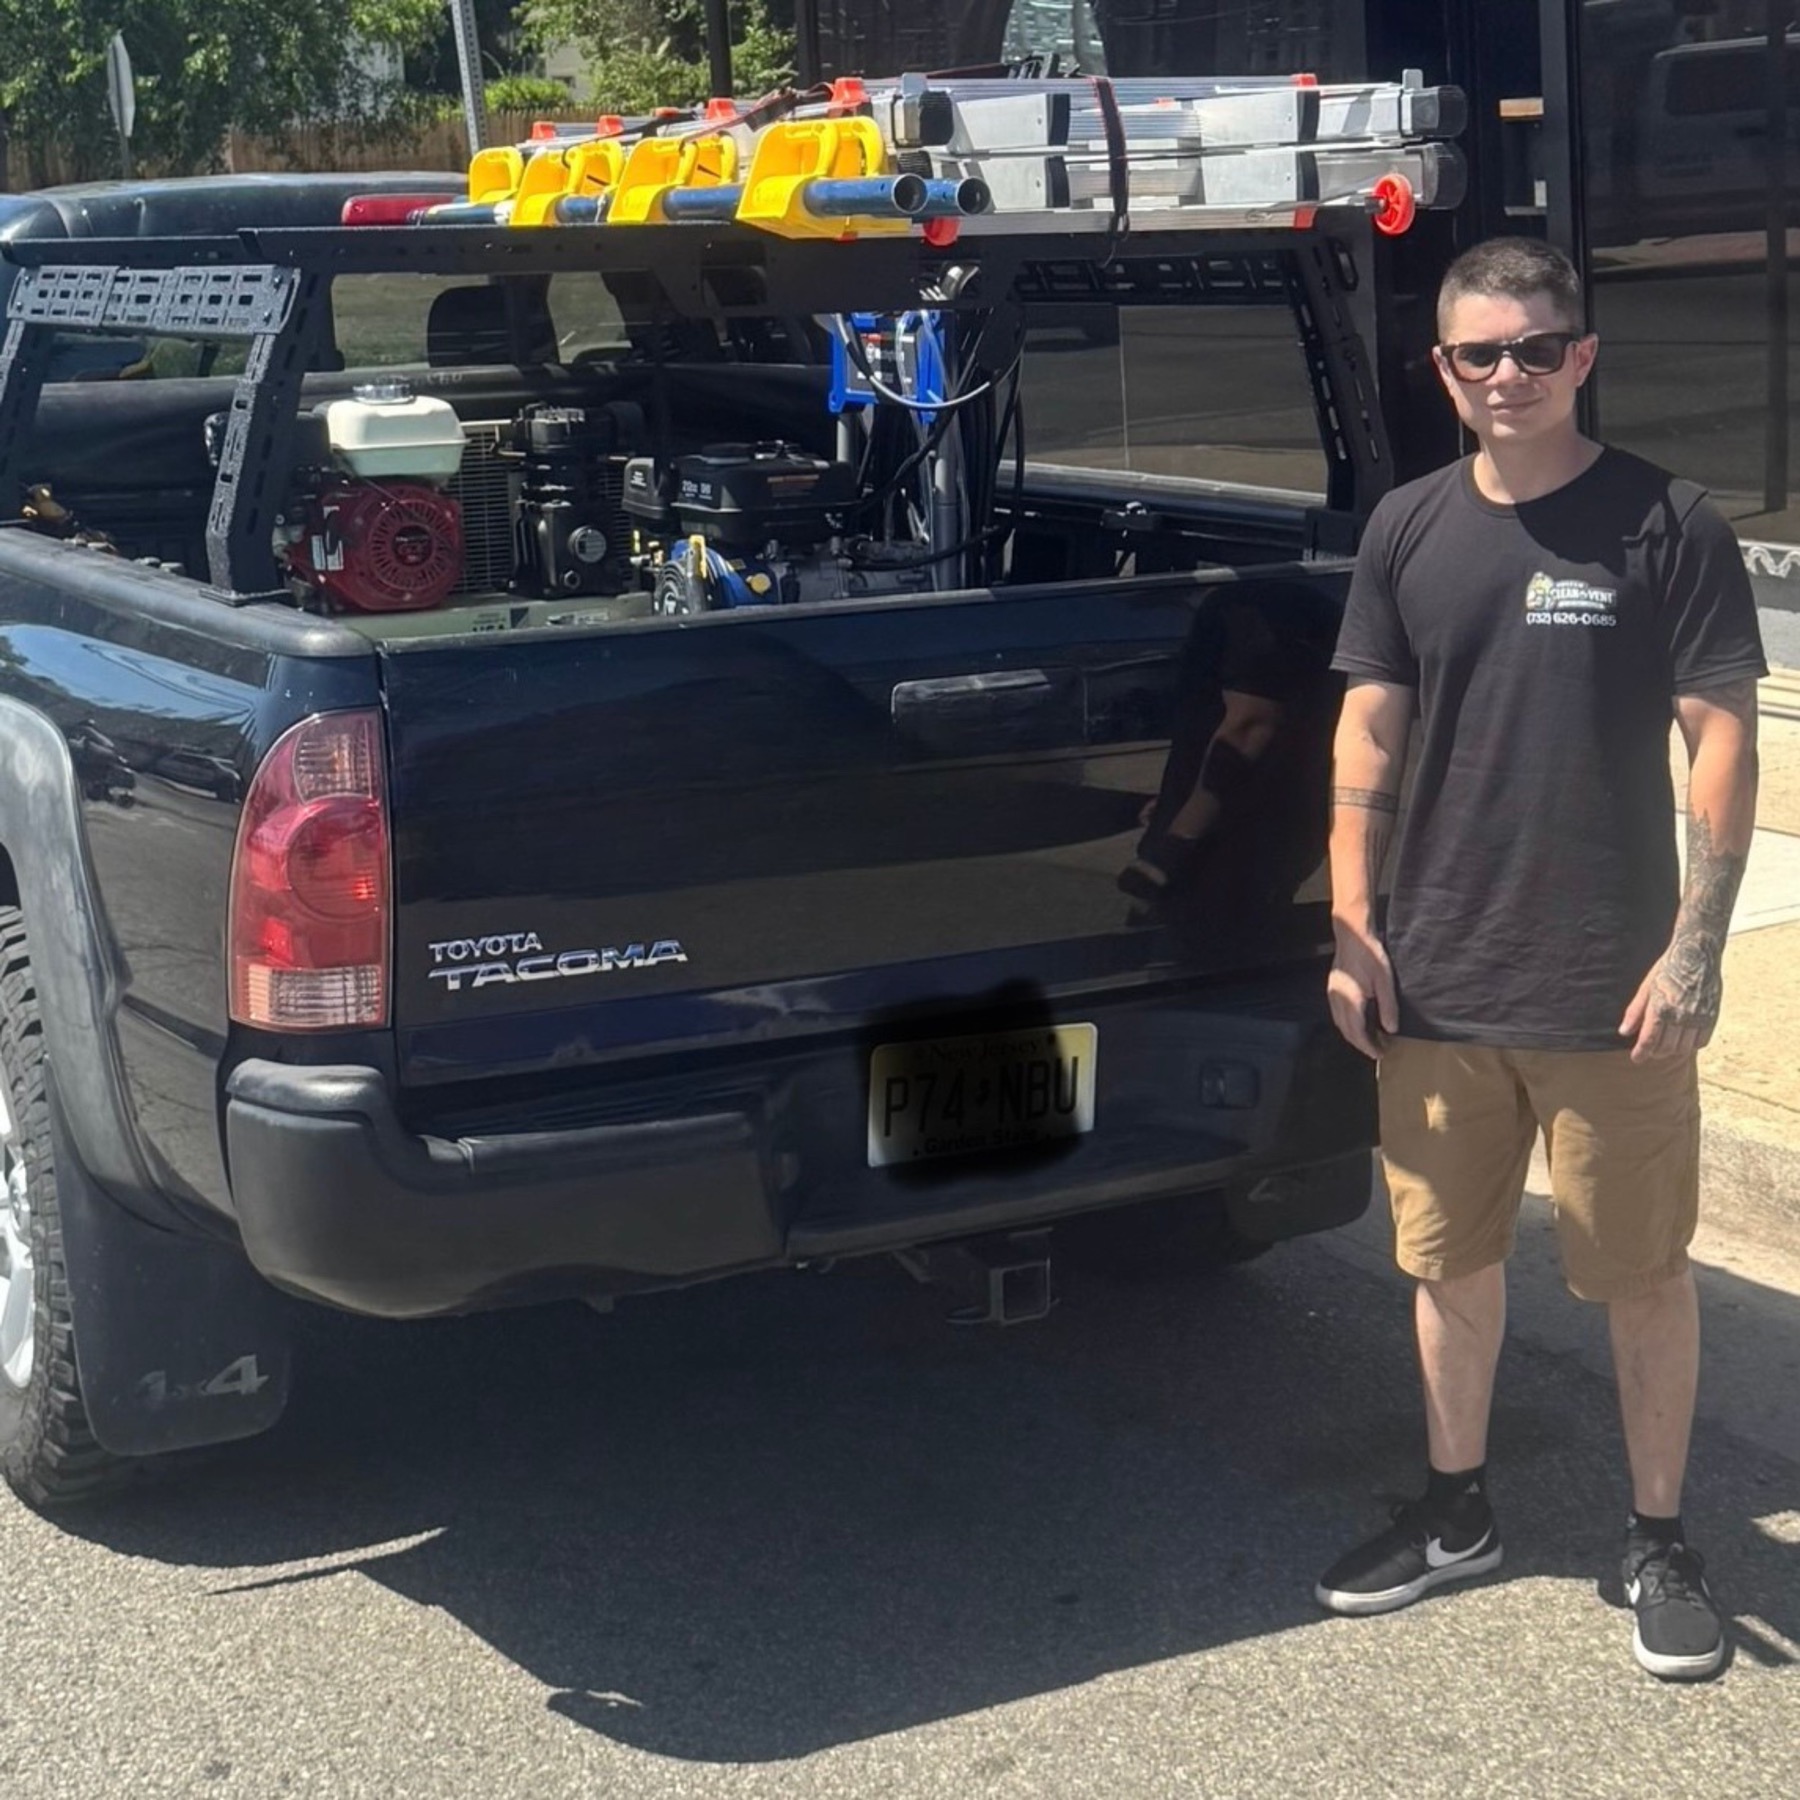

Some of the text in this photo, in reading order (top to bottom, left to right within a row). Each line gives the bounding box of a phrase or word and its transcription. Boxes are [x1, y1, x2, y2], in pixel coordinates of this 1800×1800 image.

[1553, 612, 1617, 627] 626-0685
[428, 932, 542, 962] TOYOTA
[428, 939, 688, 990] TACOMA
